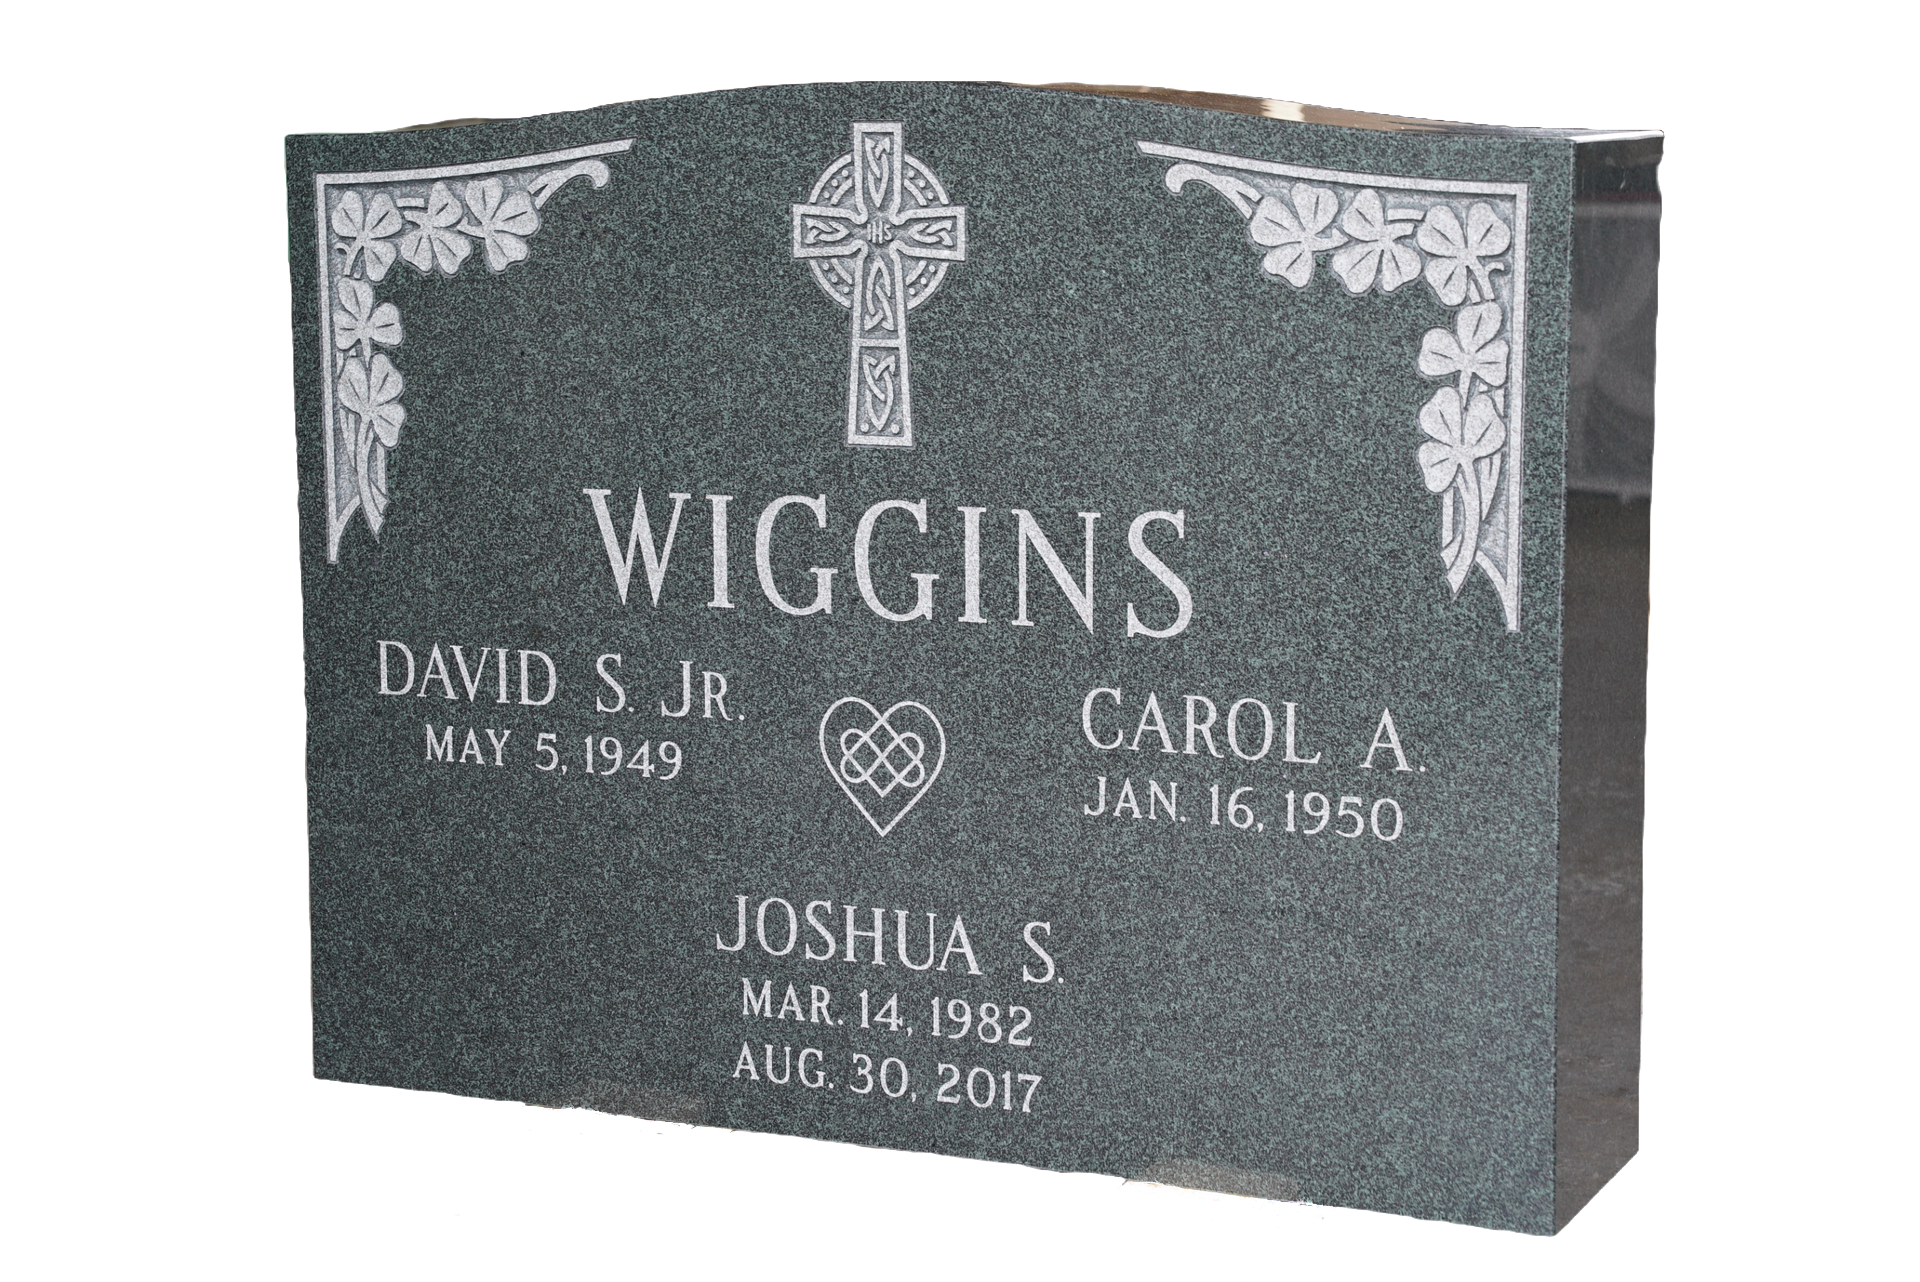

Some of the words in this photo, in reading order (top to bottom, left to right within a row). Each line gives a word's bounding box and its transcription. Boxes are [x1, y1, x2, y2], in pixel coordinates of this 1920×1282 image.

[866, 220, 893, 244] IHS
[583, 486, 1196, 640] WIGGINS
[376, 640, 557, 707] DAVID
[595, 652, 635, 714] S.
[424, 723, 512, 766] MAY
[534, 732, 568, 776] 5,
[584, 734, 683, 781] 1949
[1081, 686, 1322, 765] CAROL
[1358, 706, 1427, 774] A.
[1083, 775, 1187, 823] JAN.
[1209, 783, 1264, 834] 16,
[1284, 789, 1405, 843] 1950
[715, 894, 984, 976] JOSHUA
[1021, 920, 1065, 984] S.
[741, 977, 844, 1027] MAR.
[859, 988, 913, 1038] 14,
[930, 996, 1033, 1047] 1982
[732, 1041, 836, 1090] AUG.
[849, 1052, 917, 1104] 30,
[936, 1062, 1043, 1114] 2017
